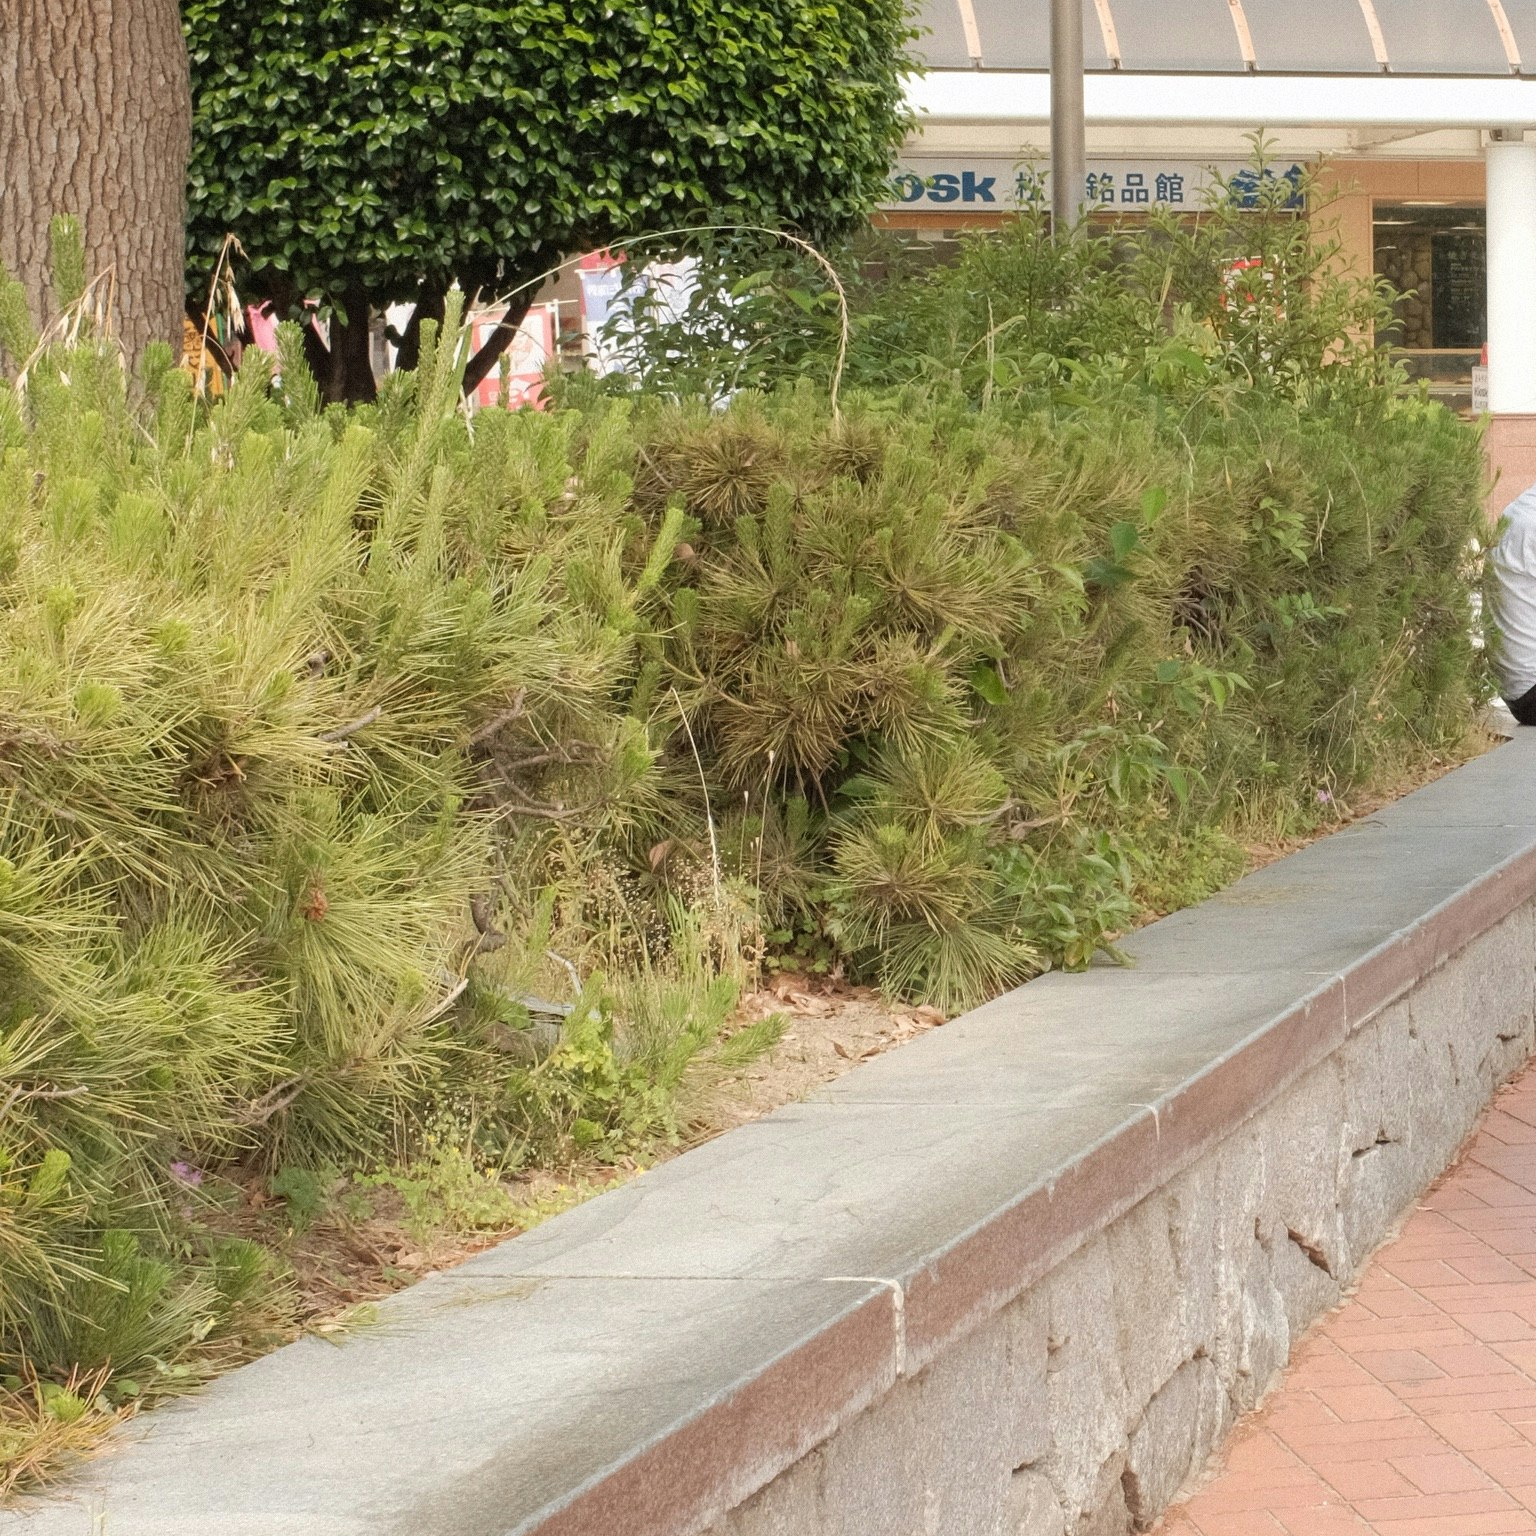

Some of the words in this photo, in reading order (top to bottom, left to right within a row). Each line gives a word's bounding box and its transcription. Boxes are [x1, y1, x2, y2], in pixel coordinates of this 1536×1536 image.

[894, 171, 997, 202] osk
[1015, 171, 1185, 203] 松銘品館
